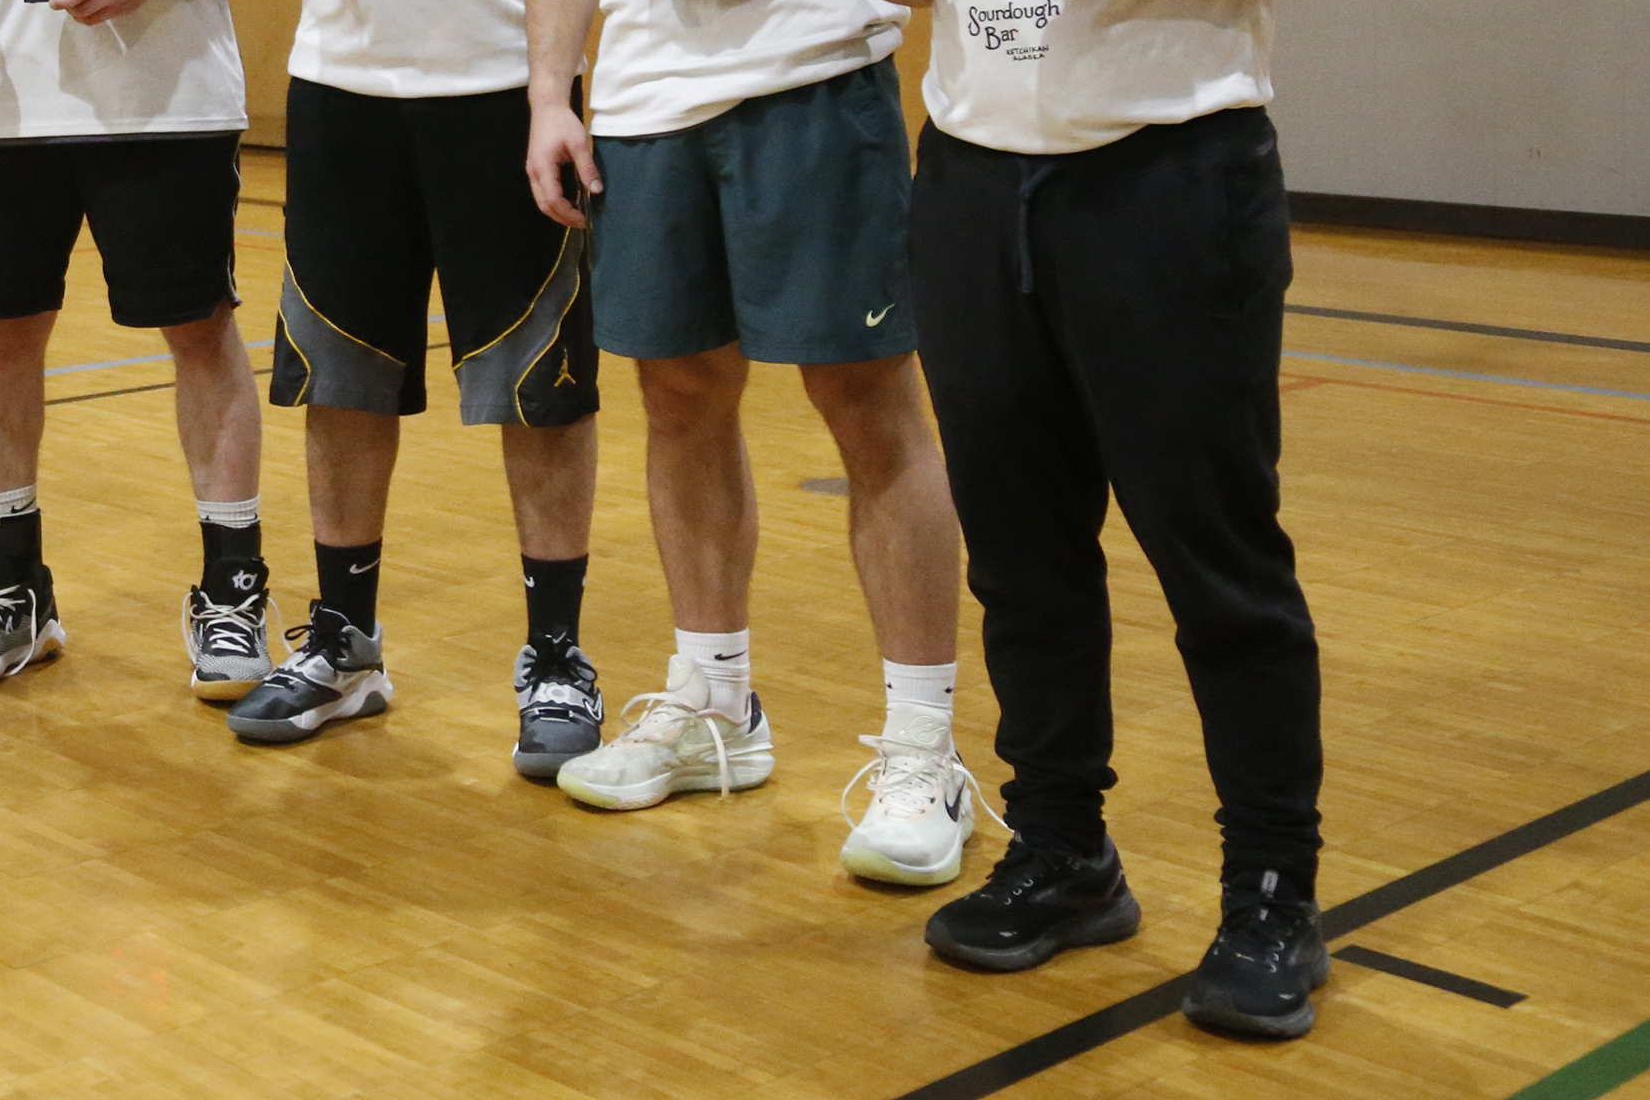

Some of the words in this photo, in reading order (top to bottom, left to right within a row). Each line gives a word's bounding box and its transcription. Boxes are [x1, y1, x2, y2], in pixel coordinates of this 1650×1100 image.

[968, 0, 1060, 36] Sourdough
[984, 27, 1018, 50] Bar
[1006, 45, 1049, 55] KETCHIKAN
